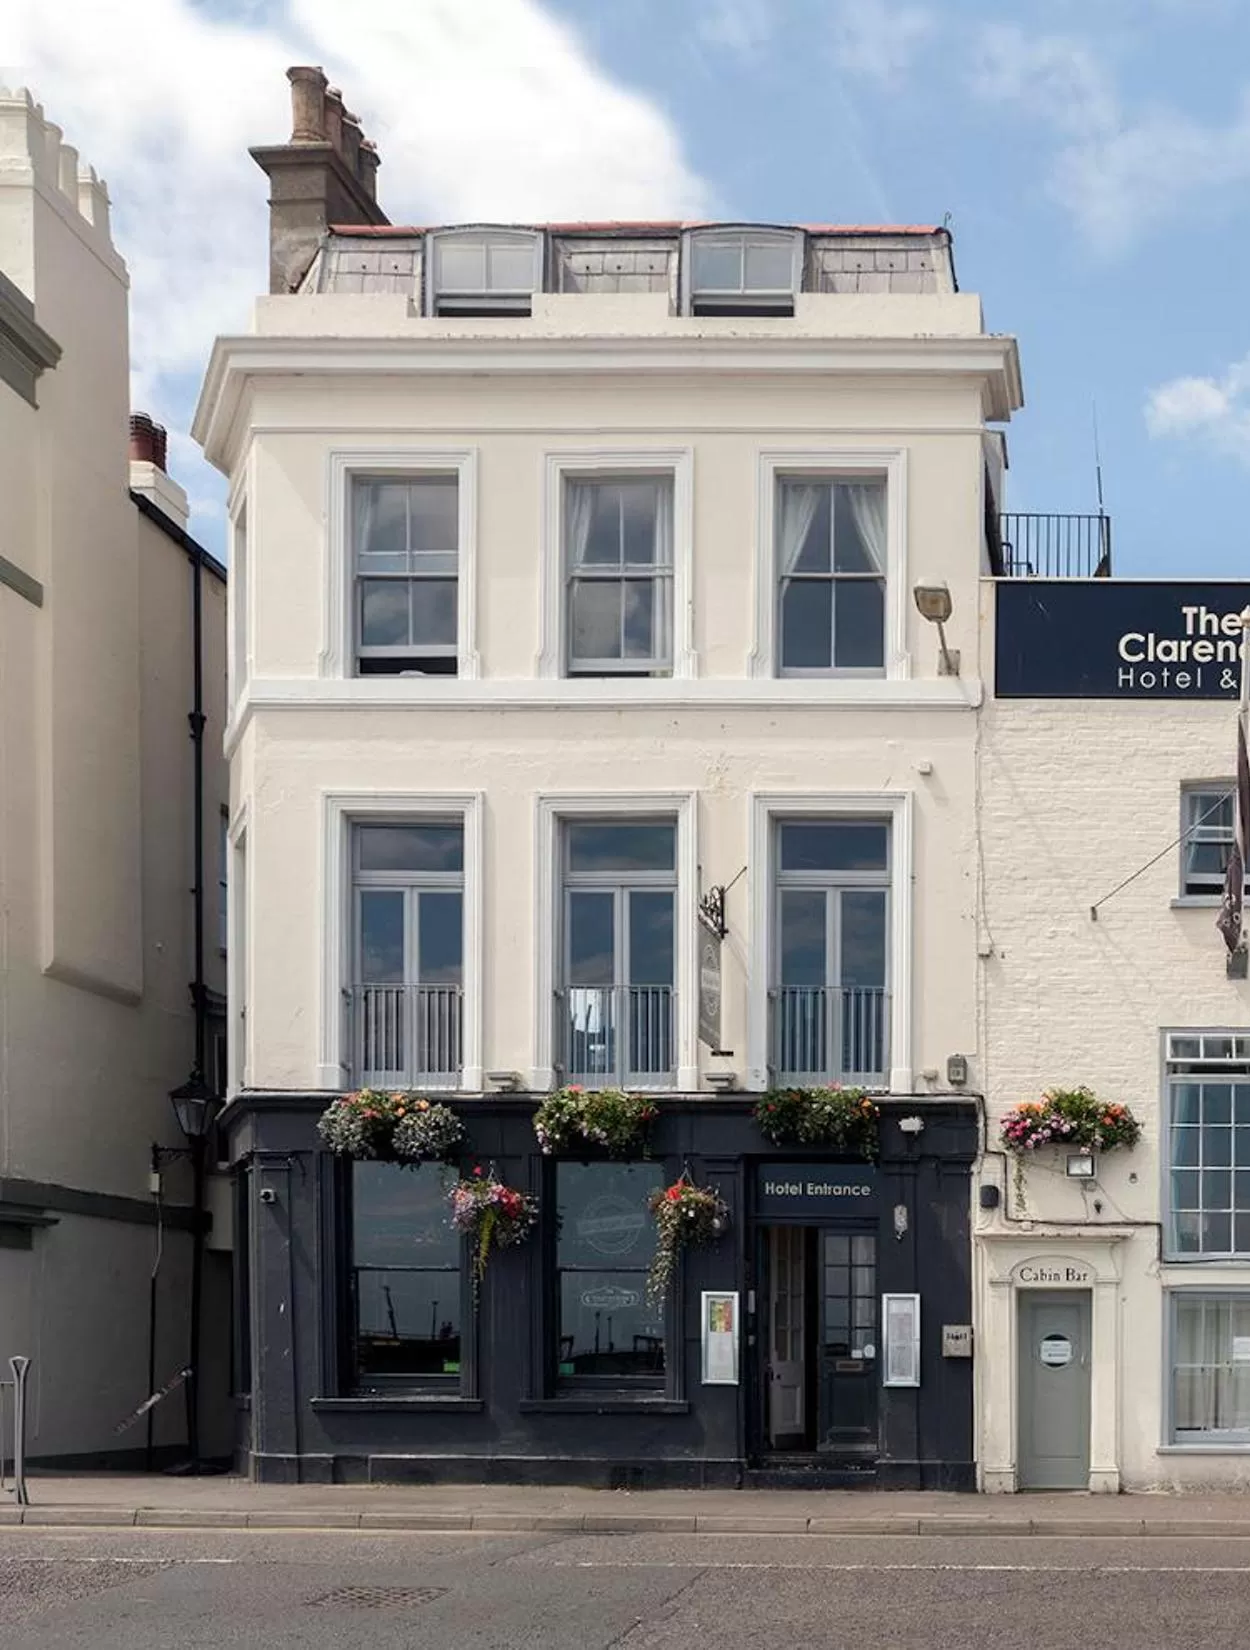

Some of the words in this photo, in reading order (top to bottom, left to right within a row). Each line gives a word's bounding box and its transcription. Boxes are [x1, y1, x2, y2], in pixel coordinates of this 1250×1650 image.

[1182, 606, 1242, 636] The
[1118, 667, 1201, 689] Hotel
[1220, 668, 1238, 689] &
[765, 1182, 802, 1195] Hotel
[806, 1183, 871, 1196] Entrance
[1020, 1267, 1060, 1281] Cabin
[1066, 1267, 1087, 1281] Bar
